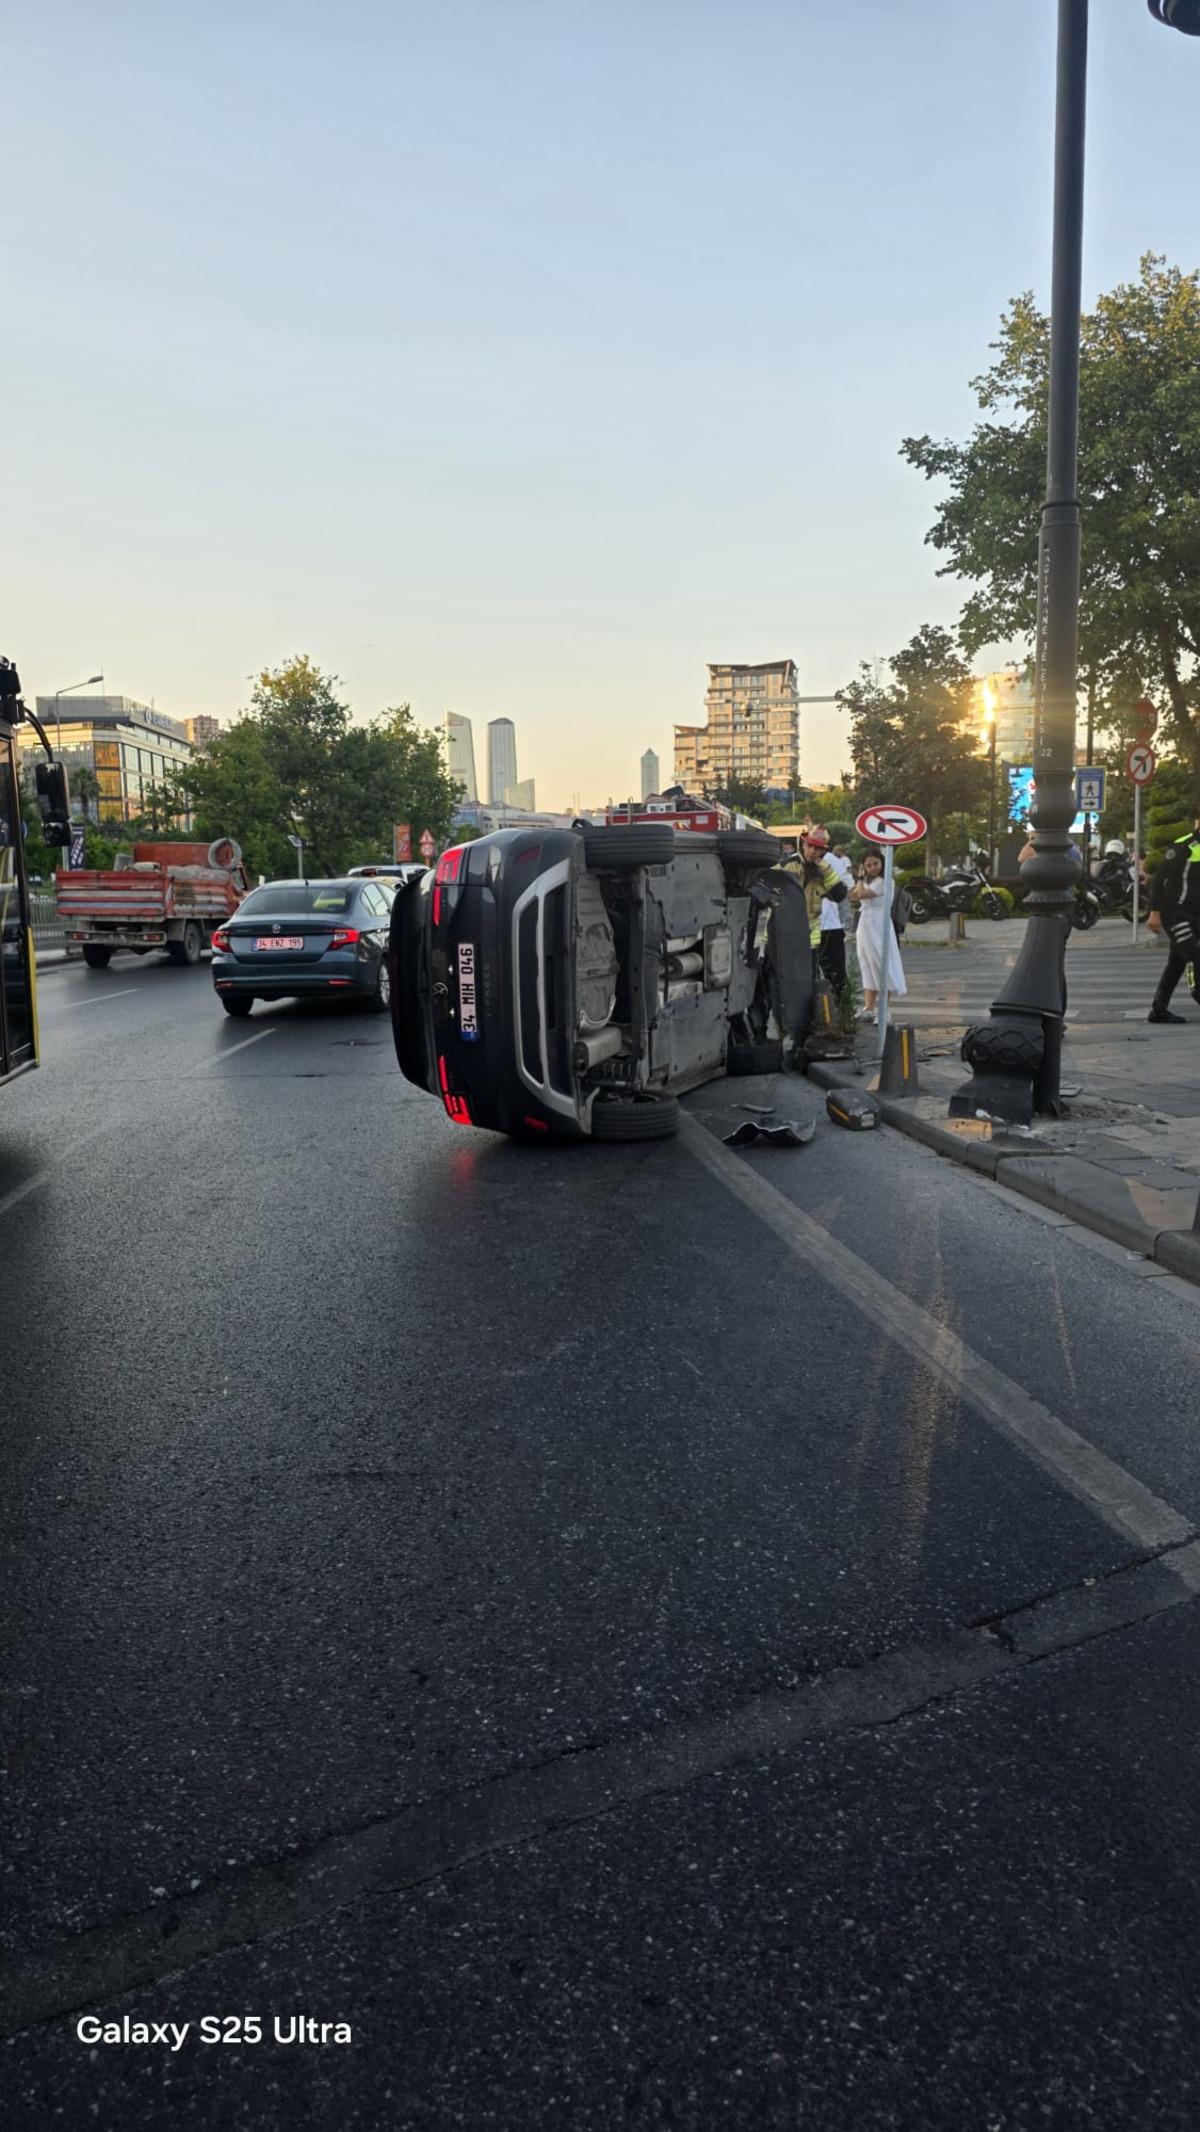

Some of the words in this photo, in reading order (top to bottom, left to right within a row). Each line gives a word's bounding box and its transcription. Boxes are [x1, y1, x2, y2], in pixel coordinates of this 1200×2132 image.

[460, 948, 474, 975] 046
[461, 983, 475, 1005] MIH
[463, 1014, 476, 1032] 34
